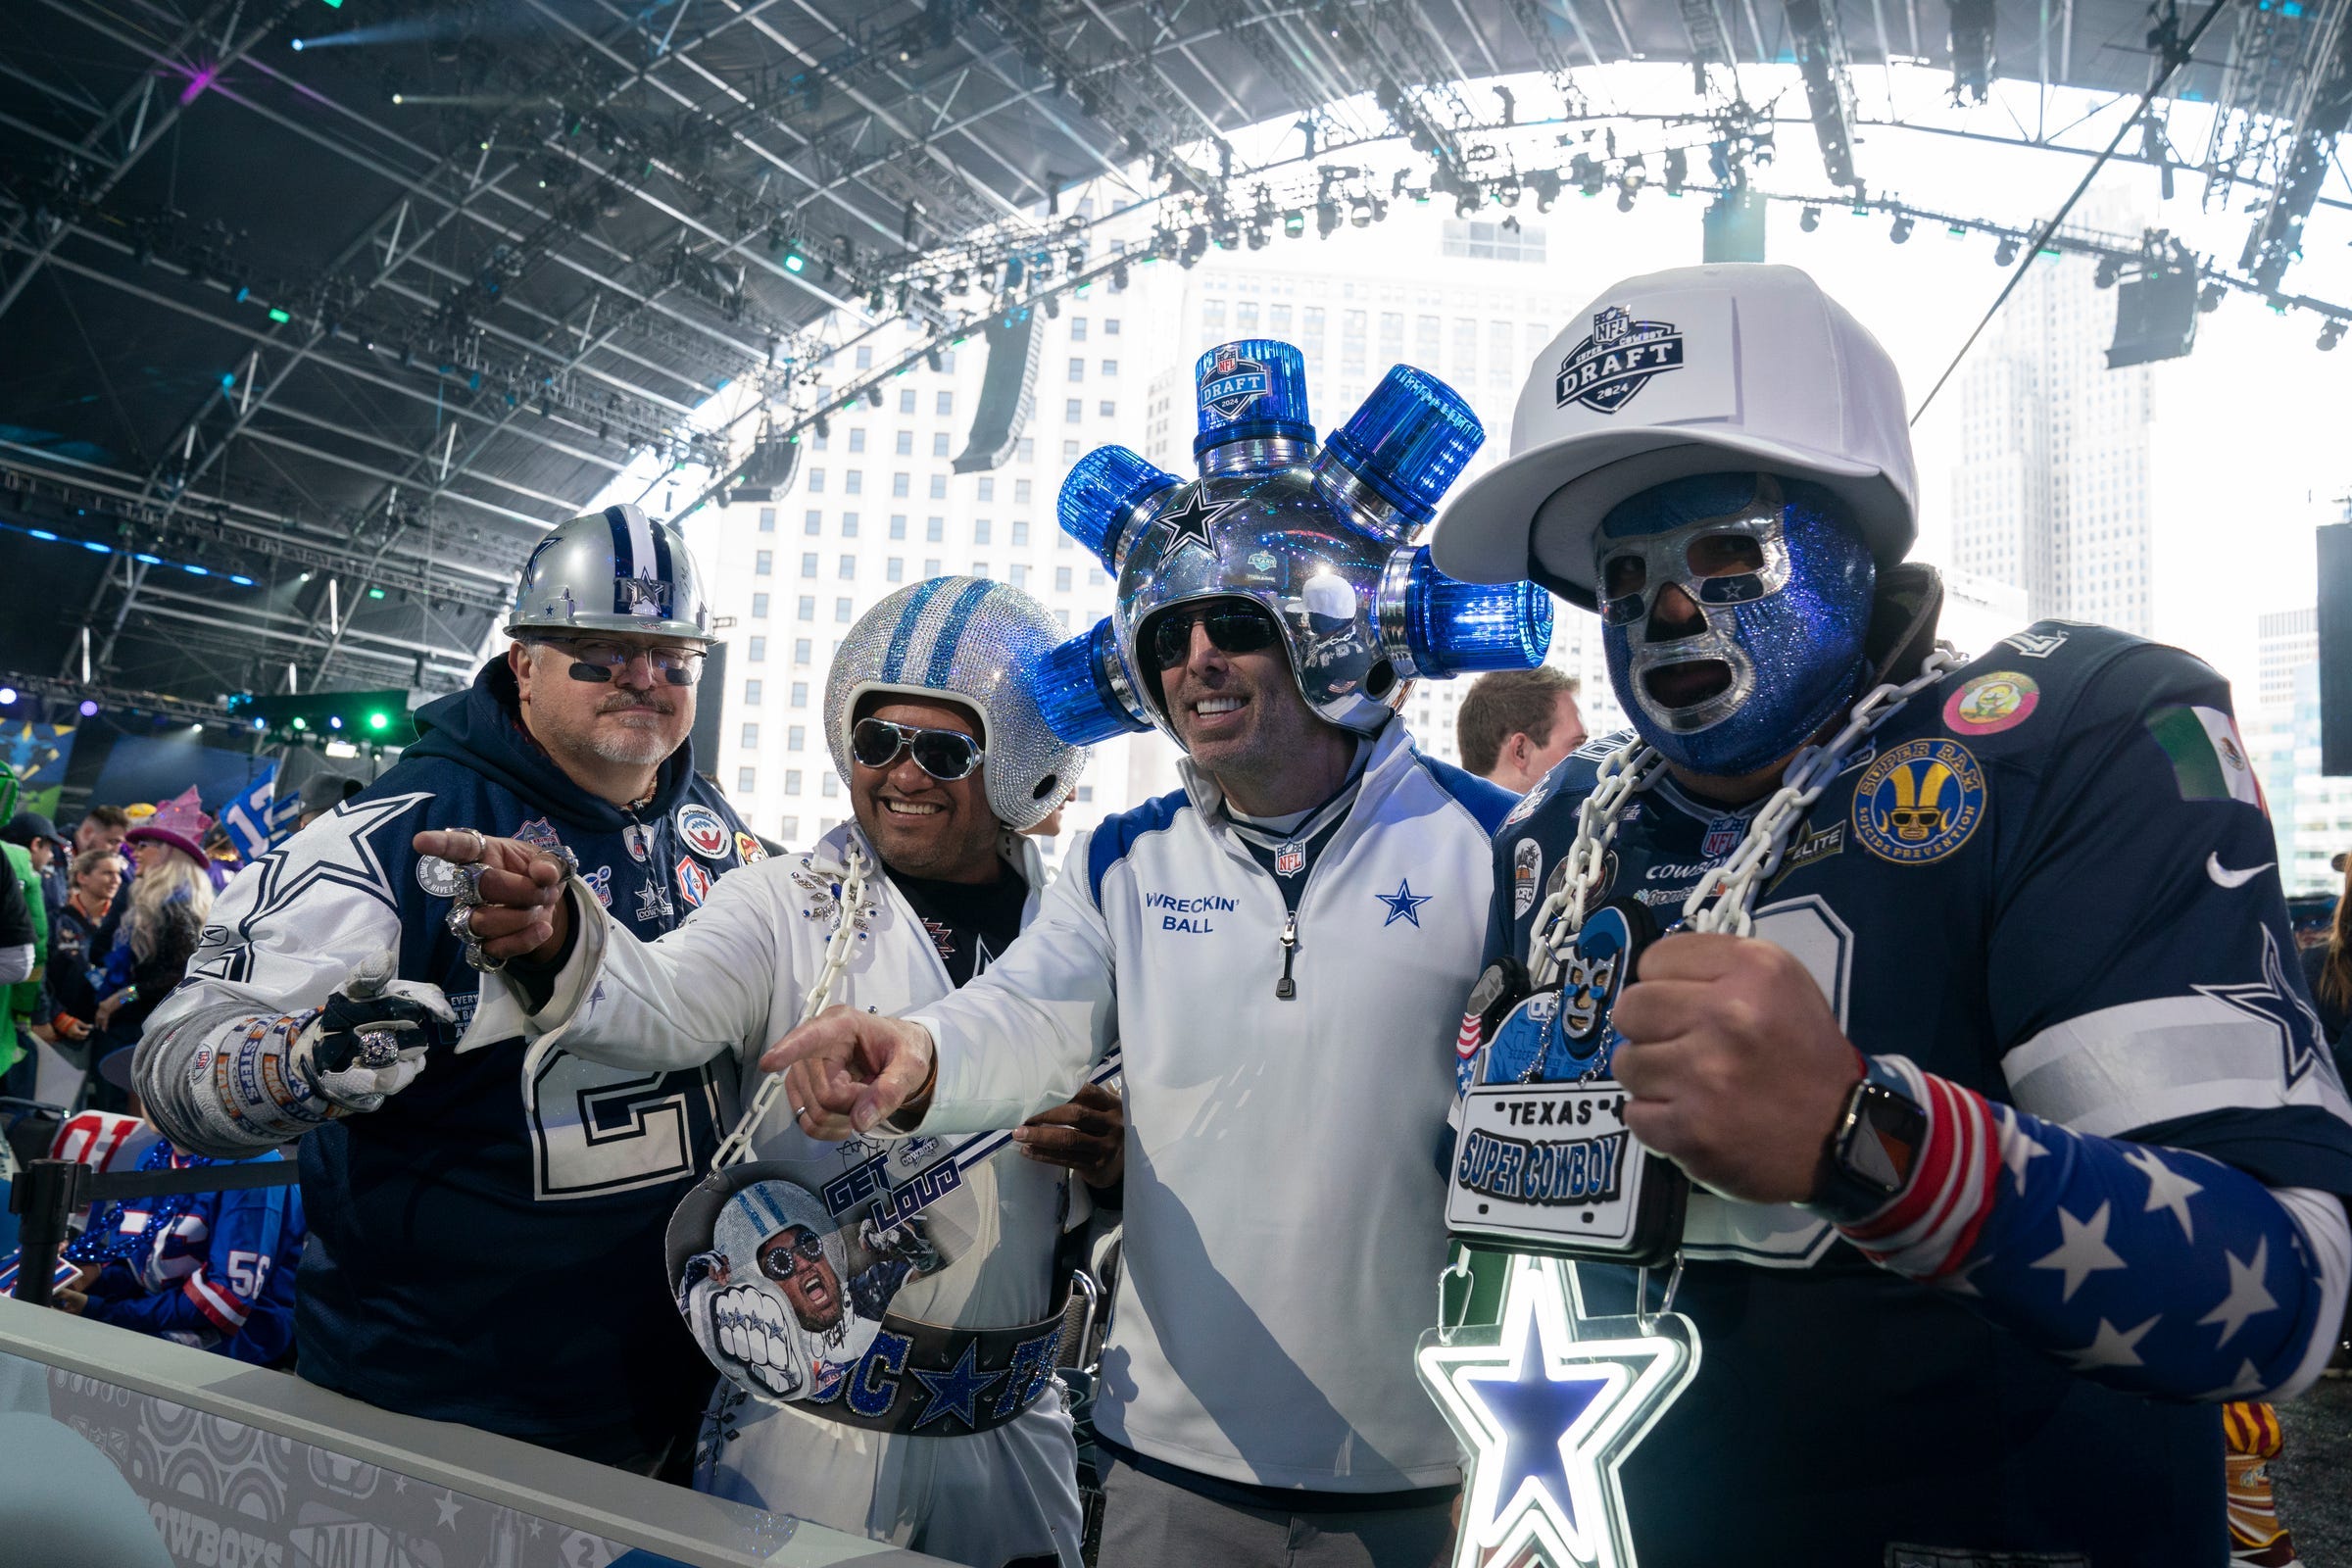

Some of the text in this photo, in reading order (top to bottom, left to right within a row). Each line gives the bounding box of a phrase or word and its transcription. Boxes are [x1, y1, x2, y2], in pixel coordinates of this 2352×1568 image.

[1597, 318, 1626, 340] NFL
[1619, 329, 1664, 346] COWBOY
[1218, 359, 1235, 371] NFL
[1562, 343, 1673, 396] DRAFT
[1203, 376, 1260, 402] DRAFT
[1597, 383, 1629, 400] 2024
[1221, 398, 1239, 408] 2024
[1860, 743, 1981, 796] SUPER RAM
[1707, 833, 1734, 855] NFL
[1792, 829, 1840, 859] ELITE
[1860, 806, 1976, 858] SUICIDE PREVENTION
[1279, 853, 1301, 871] NFL
[1645, 857, 1727, 880] COWBO
[1146, 892, 1240, 913] WRECKIN'
[1162, 915, 1213, 934] BALL
[239, 1041, 260, 1100] STEPS
[1508, 1100, 1592, 1126] TEXAS
[900, 1138, 939, 1166] COWBOYS
[1458, 1131, 1623, 1200] SUPER COWBOY
[824, 1152, 893, 1218] GET
[870, 1155, 964, 1234] LOUD
[227, 1250, 270, 1299] 56
[143, 1498, 283, 1568] OWBOYS
